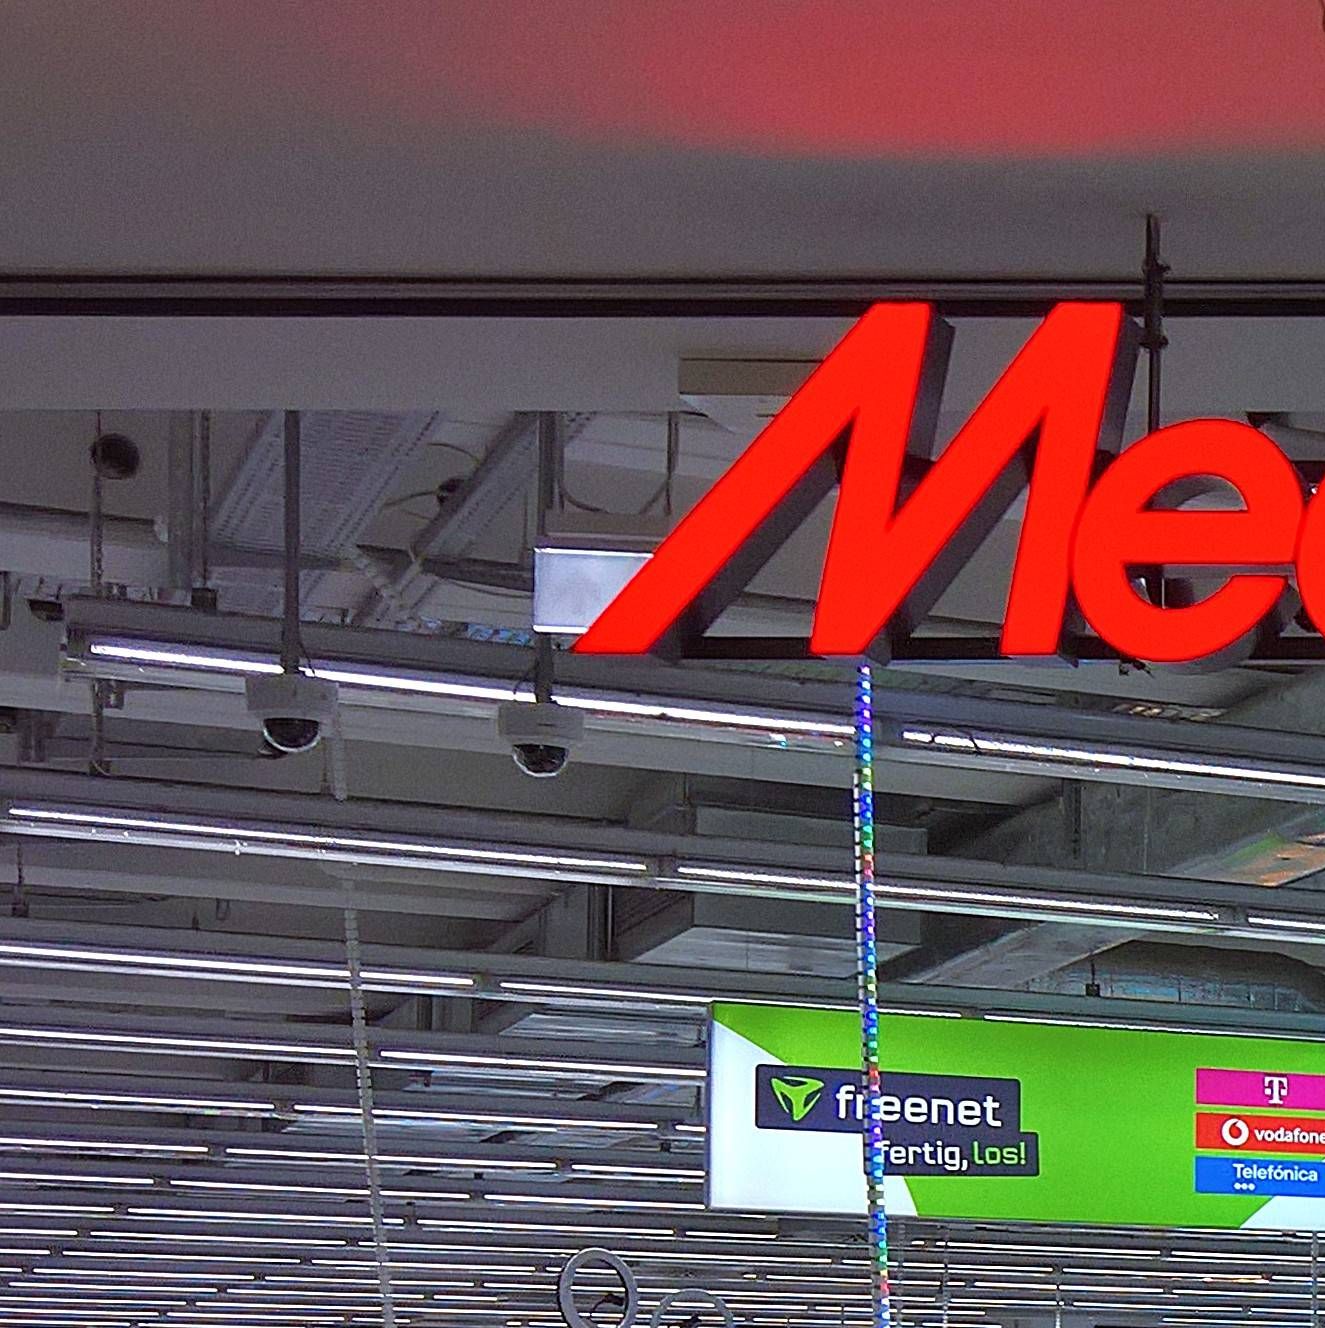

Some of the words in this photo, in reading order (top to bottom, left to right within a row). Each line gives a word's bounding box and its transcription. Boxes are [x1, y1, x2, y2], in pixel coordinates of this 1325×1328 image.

[880, 1140, 968, 1171] fertig,
[973, 1141, 1026, 1165] los!
[1232, 1163, 1318, 1183] Telefónica
